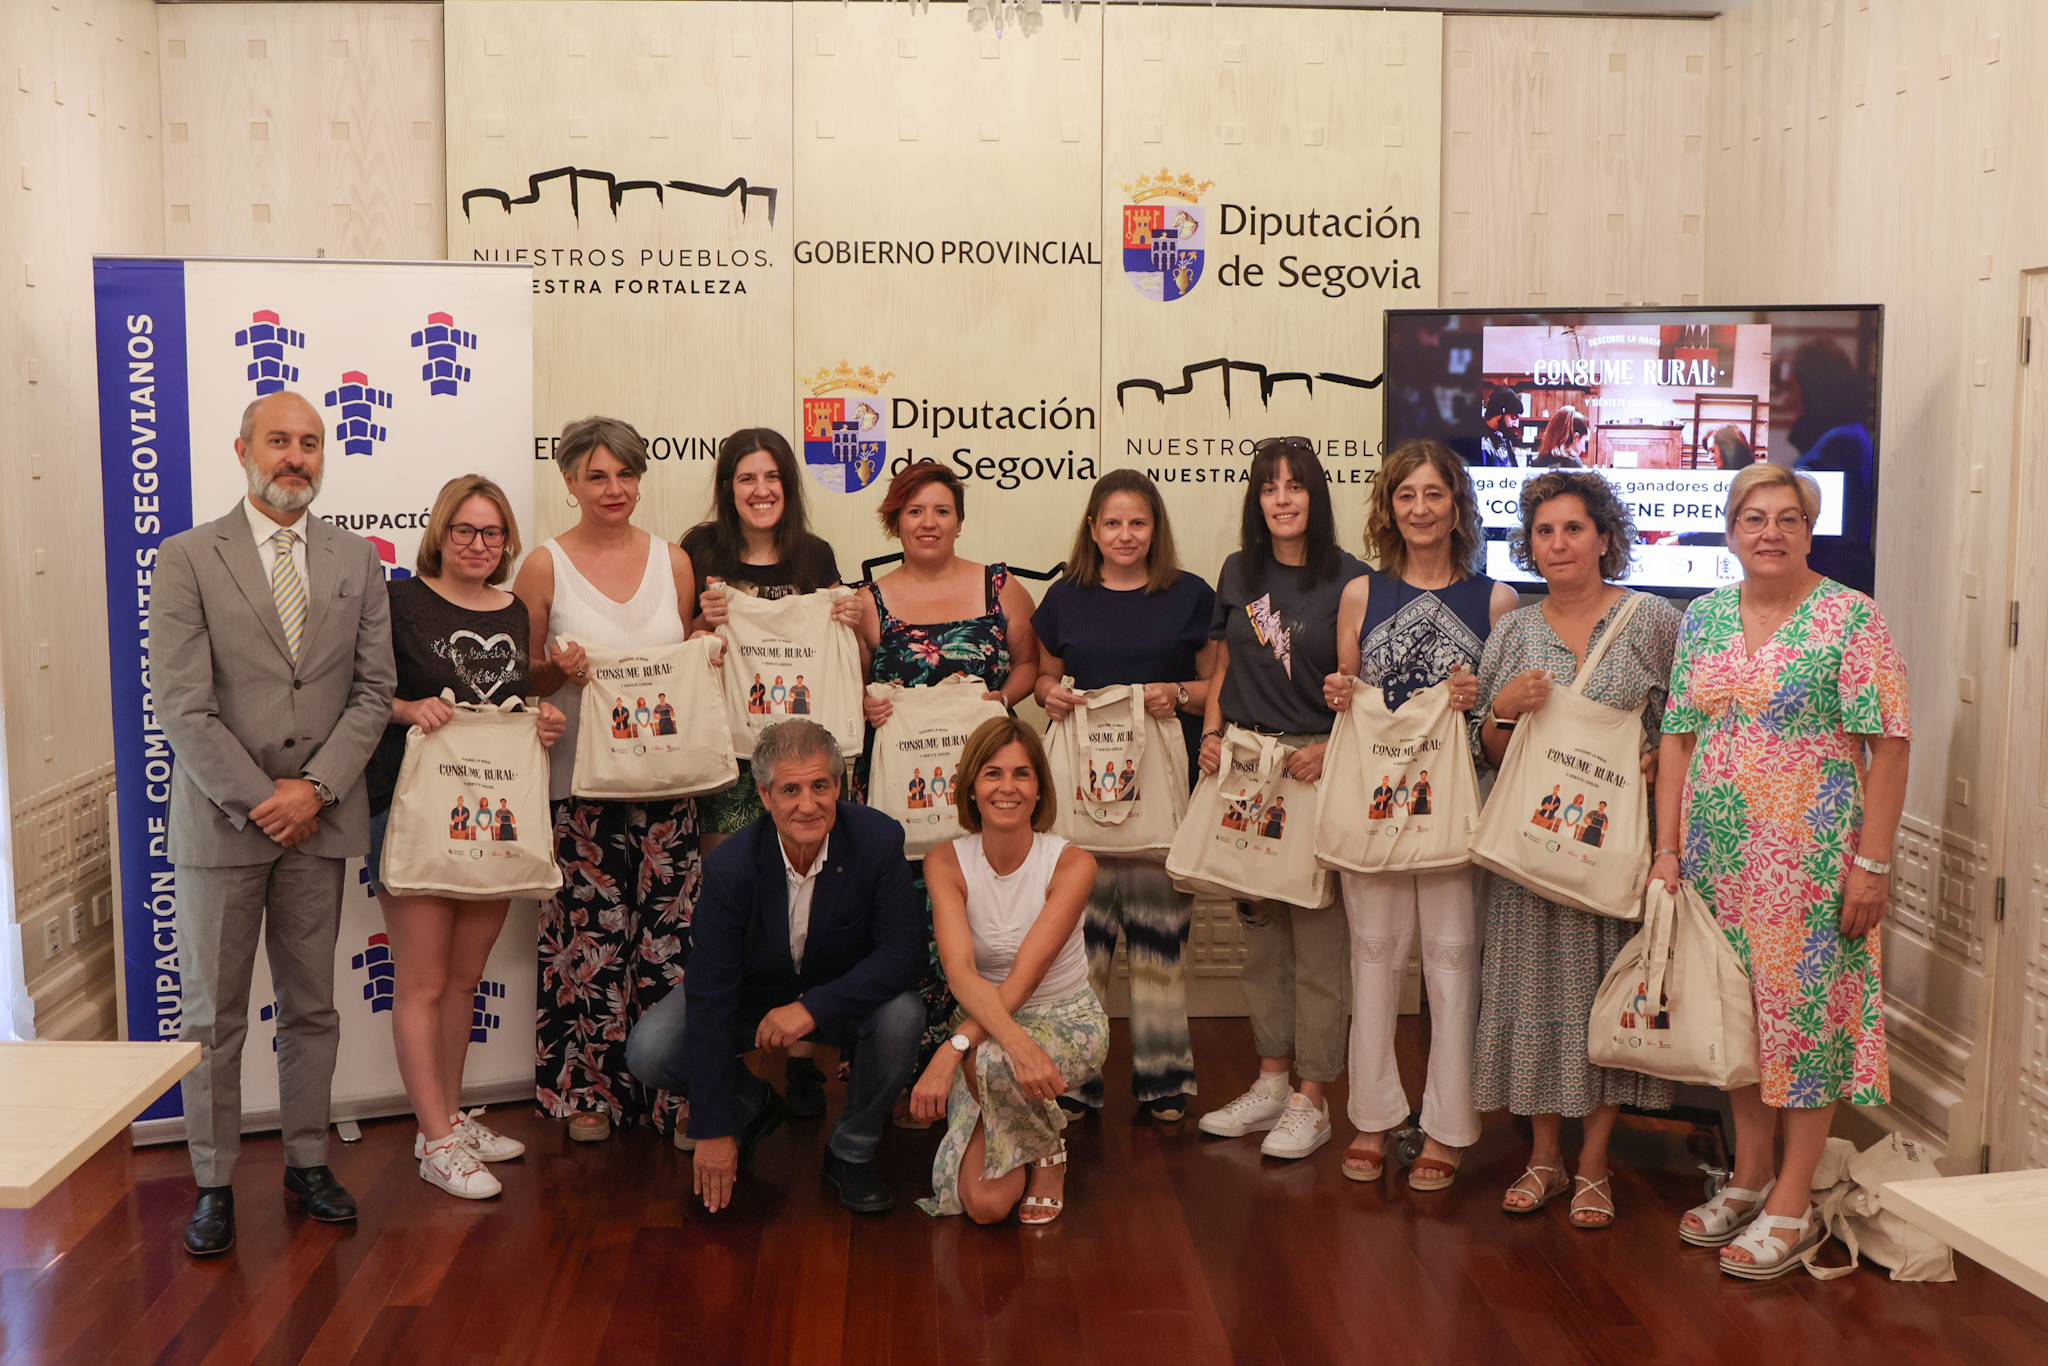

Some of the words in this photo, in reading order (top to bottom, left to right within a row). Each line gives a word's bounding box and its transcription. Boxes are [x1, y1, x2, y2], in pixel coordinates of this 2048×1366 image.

[1220, 204, 1420, 245] Diputación
[473, 249, 625, 266] NUESTROS
[641, 249, 773, 268] PUEBLOS,
[794, 240, 935, 265] GOBIERNO
[941, 240, 1101, 265] PROVINCIAL
[1218, 254, 1264, 287] de
[1278, 255, 1421, 298] Segovia
[533, 279, 602, 294] ESTRA
[615, 279, 747, 294] FORTALEZA
[1588, 335, 1626, 347] DESCUBRE
[1628, 335, 1637, 343] LA
[1638, 336, 1661, 347] MAGIA
[1533, 359, 1634, 386] CONSUME
[1584, 398, 1590, 407] Y
[1592, 397, 1626, 407] SIÉNTETE
[127, 314, 160, 534] SEGOVIANOS
[892, 397, 1096, 438] Diputación
[1127, 439, 1255, 456] NUESTRO
[945, 448, 1097, 489] Segovia
[1147, 469, 1250, 483] NUESTRA
[1499, 477, 1517, 489] de
[1626, 480, 1708, 493] ganadores
[1626, 503, 1664, 517] ENE
[740, 645, 781, 658] CONSUME
[596, 667, 640, 680] CONSUME
[899, 737, 939, 751] CONSUME
[1117, 731, 1133, 743] RUR
[1372, 743, 1416, 758] CONSUME
[1547, 748, 1593, 774] CONSUME
[440, 763, 482, 779] CONSUME
[148, 817, 170, 857] DE
[143, 872, 184, 1042] RUPACIÓN
